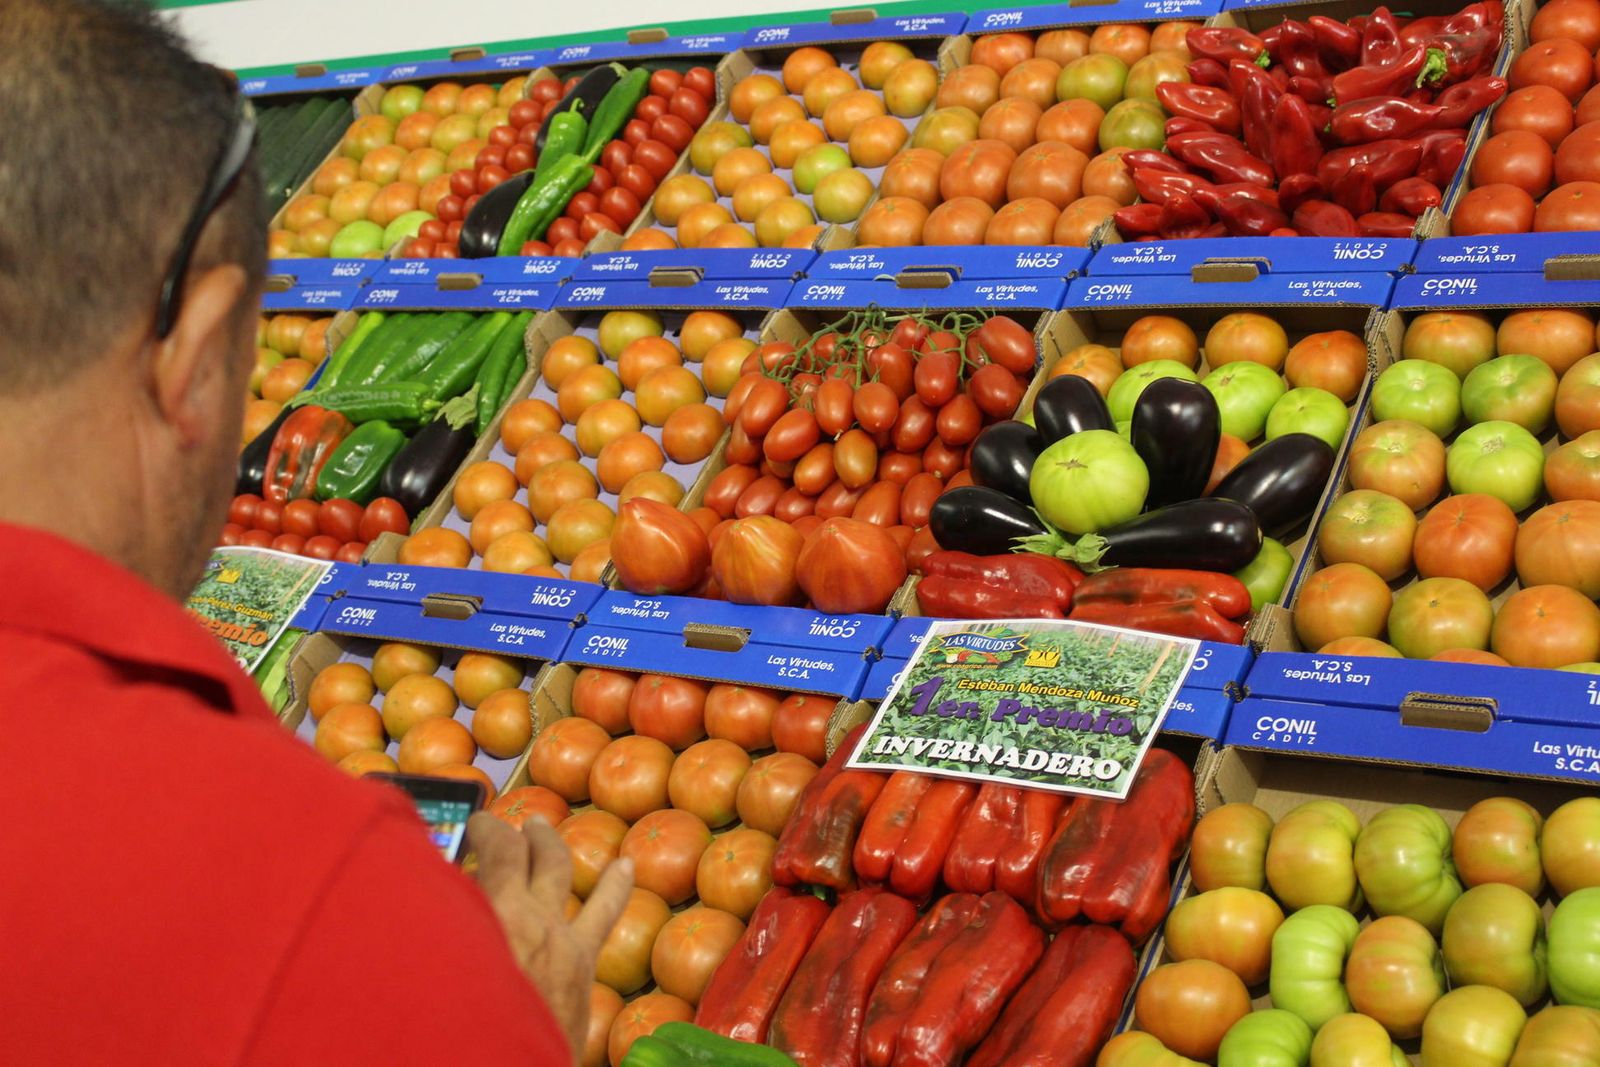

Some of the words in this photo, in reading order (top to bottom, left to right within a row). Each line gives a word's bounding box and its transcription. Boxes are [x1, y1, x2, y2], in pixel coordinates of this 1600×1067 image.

[1333, 250, 1384, 260] CONIL
[1463, 245, 1500, 254] S.C.A.
[750, 259, 787, 268] CONIL
[1016, 259, 1059, 268] CONIL
[1111, 255, 1154, 264] Virtudes,
[1438, 254, 1490, 263] Virtudes,
[1495, 254, 1516, 262] Las
[996, 285, 1038, 293] Virtudes,
[1088, 284, 1133, 295] CONIL
[1289, 281, 1309, 289] Las
[1312, 281, 1362, 290] Virtudes,
[1424, 278, 1478, 290] CONIL
[572, 287, 606, 296] CONIL
[808, 286, 846, 295] CONIL
[1303, 289, 1338, 297] S.C.A.
[532, 593, 571, 607] CONIL
[342, 607, 377, 620] CONIL
[653, 610, 669, 620] Las
[490, 623, 507, 633] Las
[508, 624, 546, 638] Virtudes,
[809, 624, 855, 638] CONIL
[588, 635, 629, 650] CONIL
[944, 635, 964, 647] LAS
[966, 636, 1017, 651] VIRTUDES
[767, 655, 787, 666] Las
[789, 656, 834, 672] Virtudes,
[1312, 659, 1353, 672] S.C.A.
[778, 667, 808, 680] S.C.A.
[1282, 668, 1342, 684] Virtudes,
[1345, 674, 1371, 686] Las
[957, 678, 1015, 692] Esteban
[1018, 682, 1084, 698] Mendoza
[1086, 690, 1140, 708] Muñoz
[990, 698, 1134, 736] Premio
[1256, 716, 1318, 735] CONIL
[1533, 741, 1561, 755] Las
[872, 735, 1123, 781] INVERNADERO
